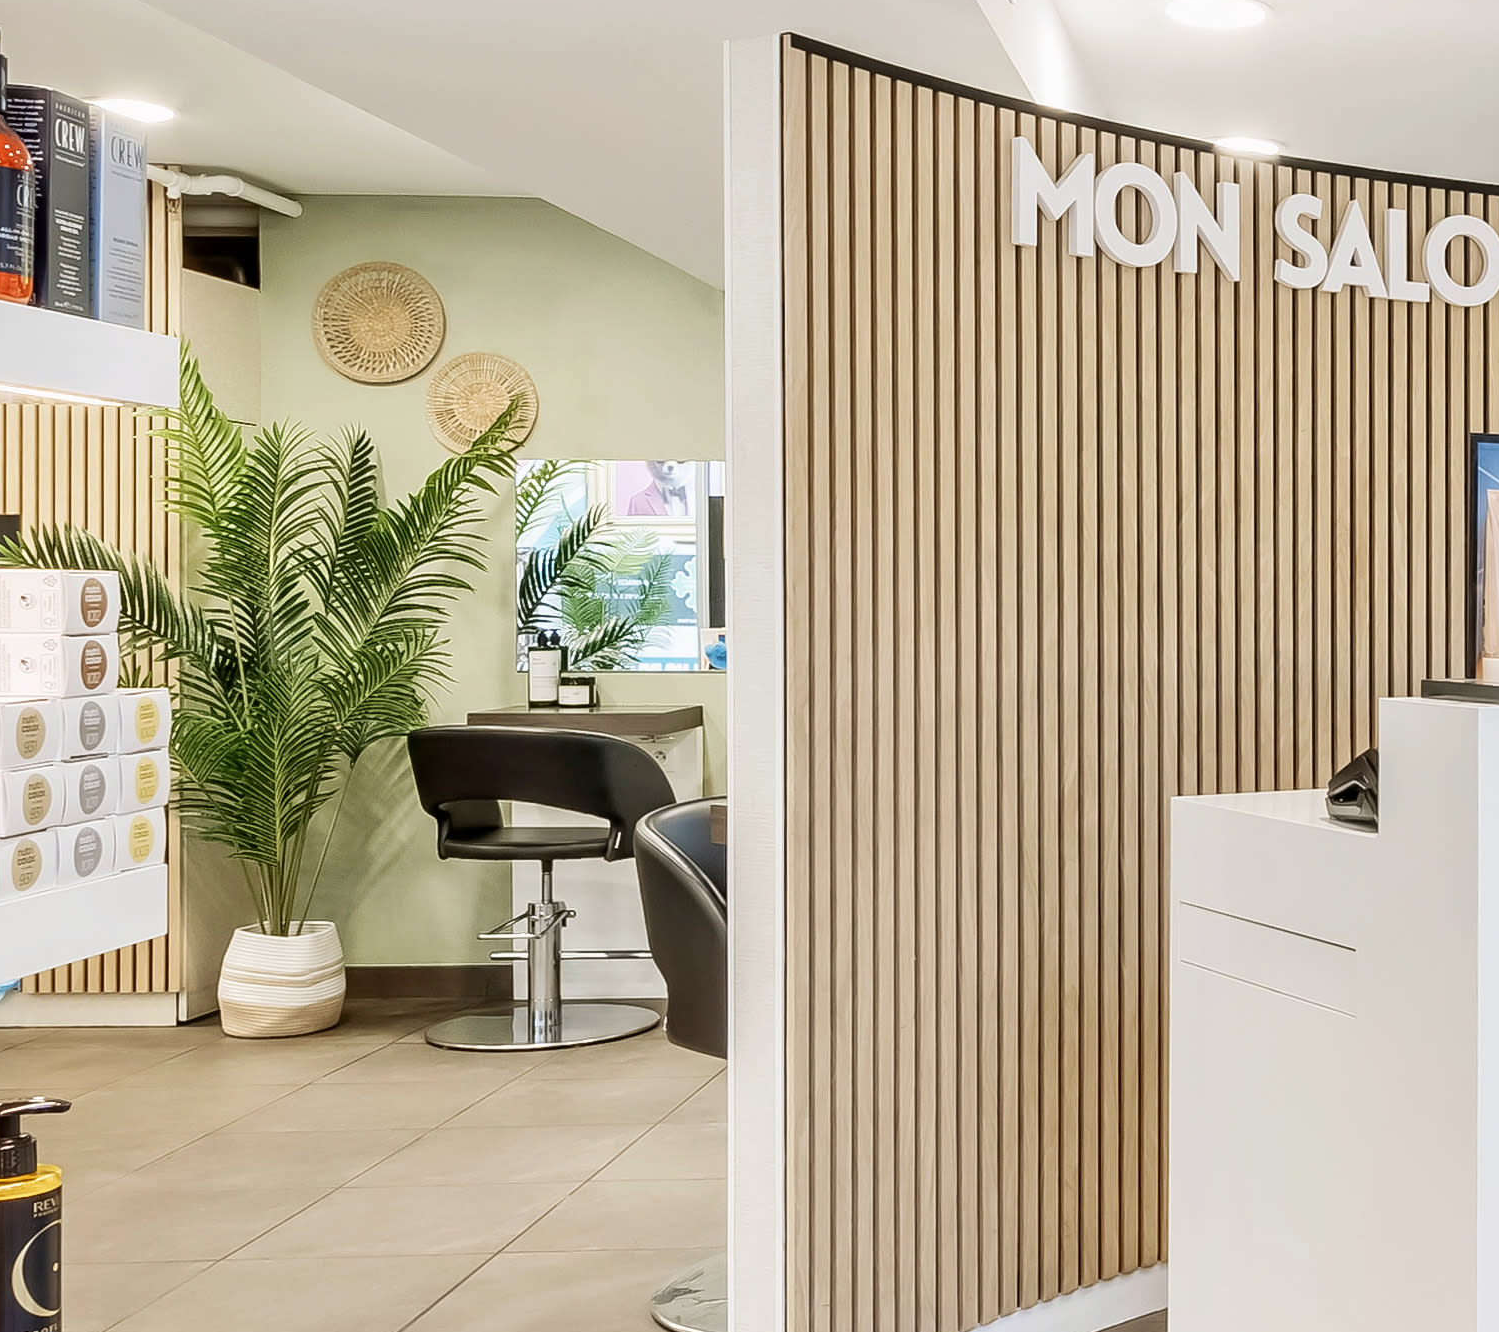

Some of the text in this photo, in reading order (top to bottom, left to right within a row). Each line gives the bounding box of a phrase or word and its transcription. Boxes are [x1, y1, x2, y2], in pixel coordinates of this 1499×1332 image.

[55, 118, 86, 155] CREW
[110, 136, 145, 168] CREW
[1011, 135, 1240, 282] MON
